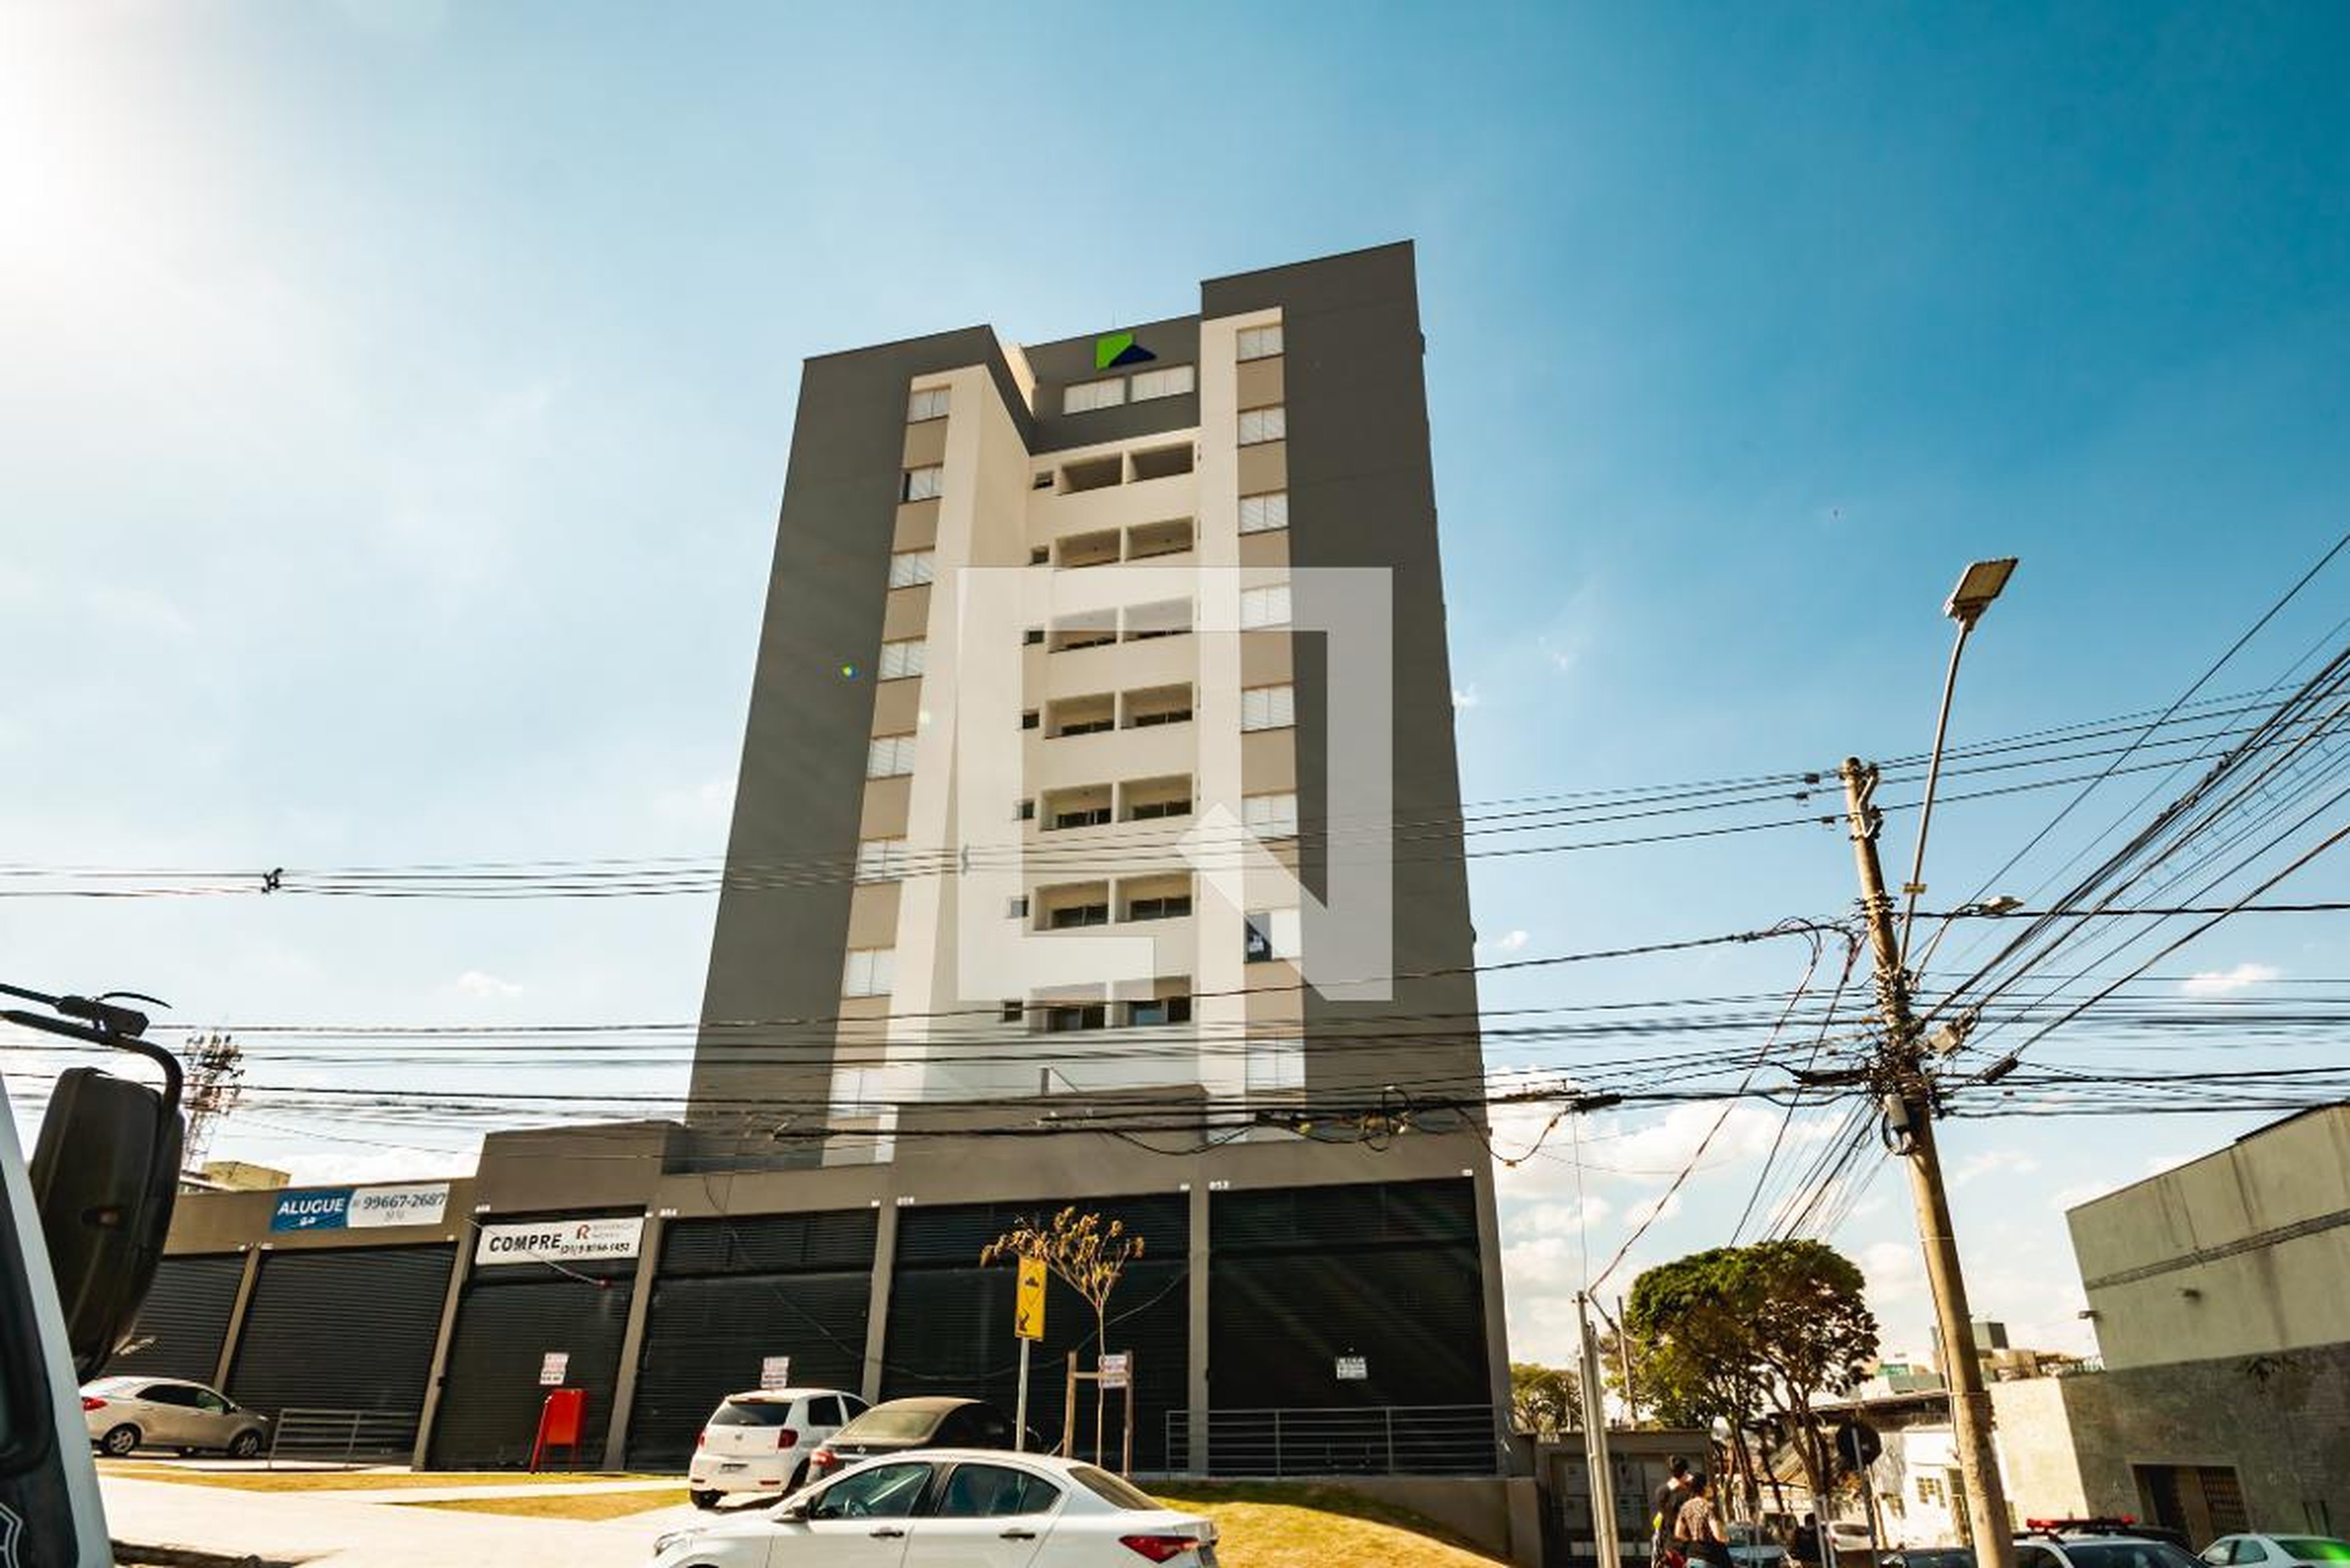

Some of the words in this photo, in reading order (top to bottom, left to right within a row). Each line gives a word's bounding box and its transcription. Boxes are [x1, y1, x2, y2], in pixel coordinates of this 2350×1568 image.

[277, 1198, 345, 1215] ALUGUE
[364, 1193, 446, 1209] 99667-2687
[490, 1234, 562, 1252] COMPRE
